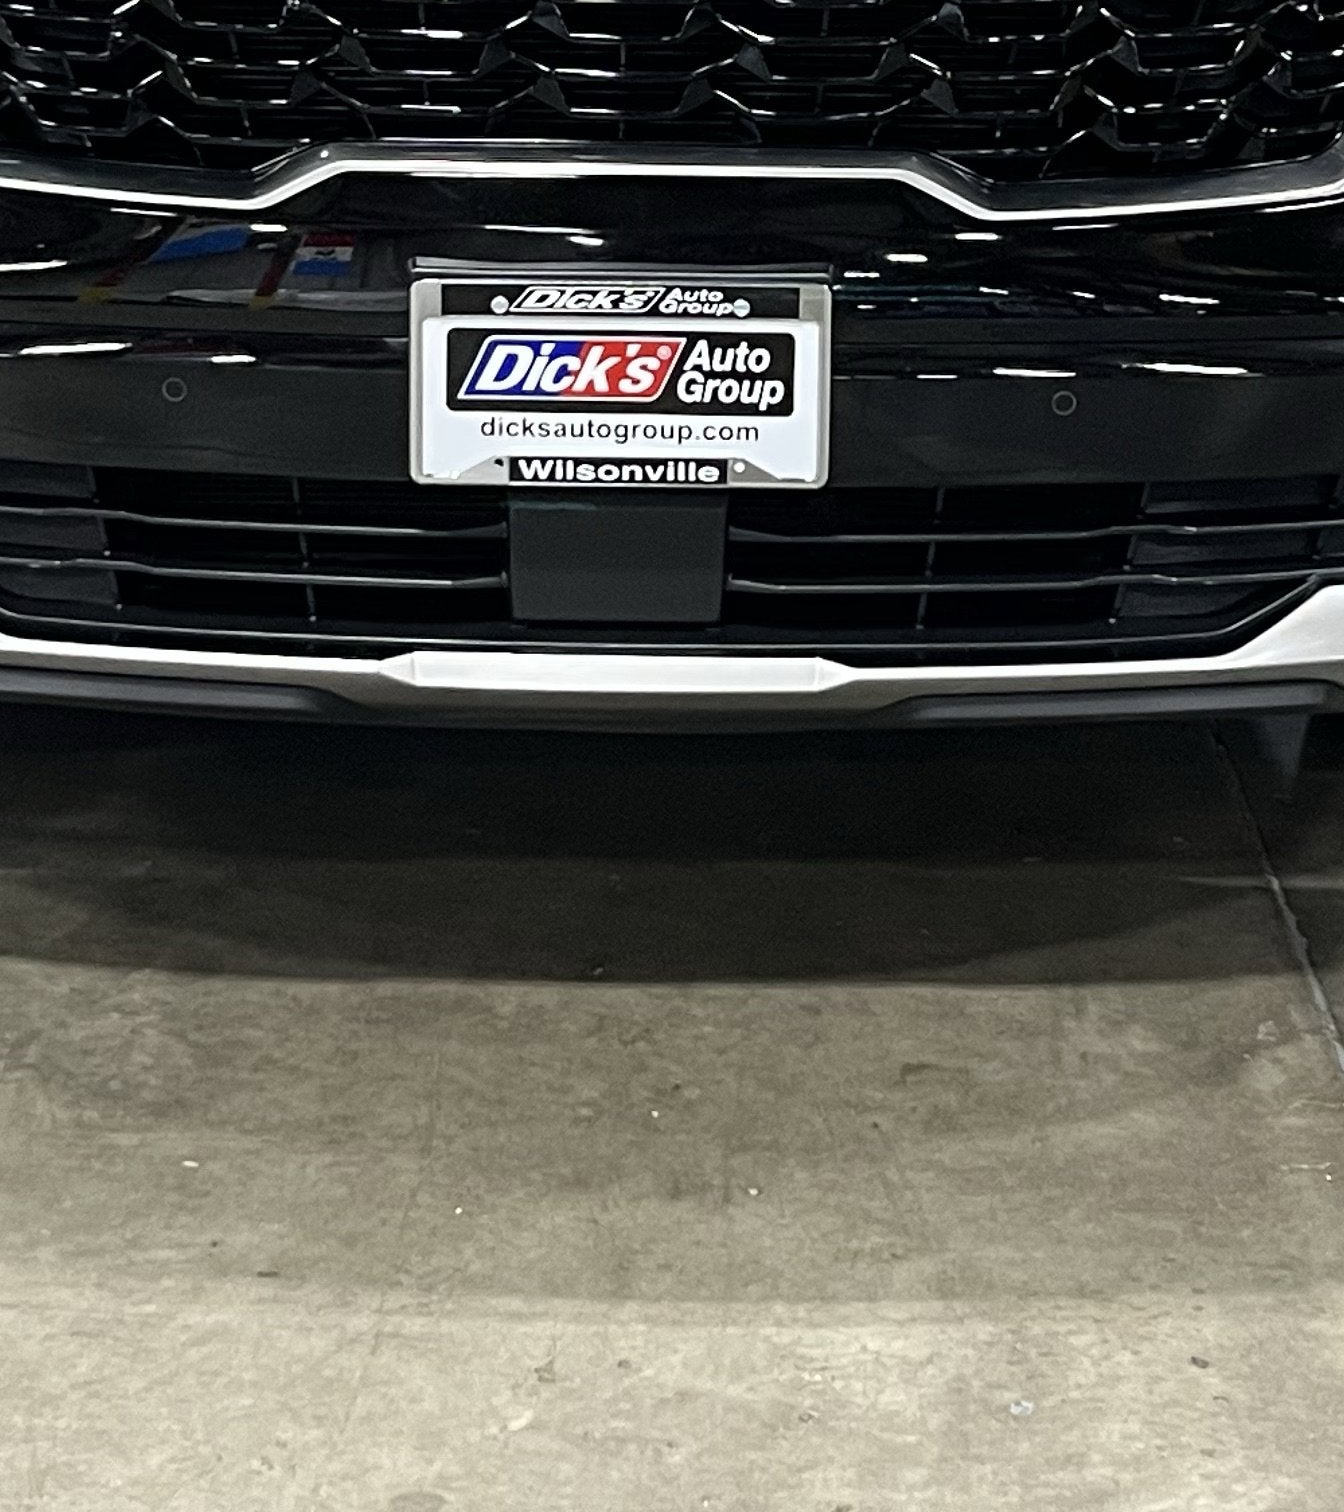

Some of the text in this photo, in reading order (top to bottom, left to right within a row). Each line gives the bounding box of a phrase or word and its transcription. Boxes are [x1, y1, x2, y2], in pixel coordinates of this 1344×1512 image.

[659, 300, 735, 316] Group
[666, 288, 724, 303] Auto
[682, 339, 771, 373] Auto
[676, 370, 785, 411] Group
[480, 417, 759, 444] dicksautogroup.com
[518, 459, 720, 482] Wilsonville
